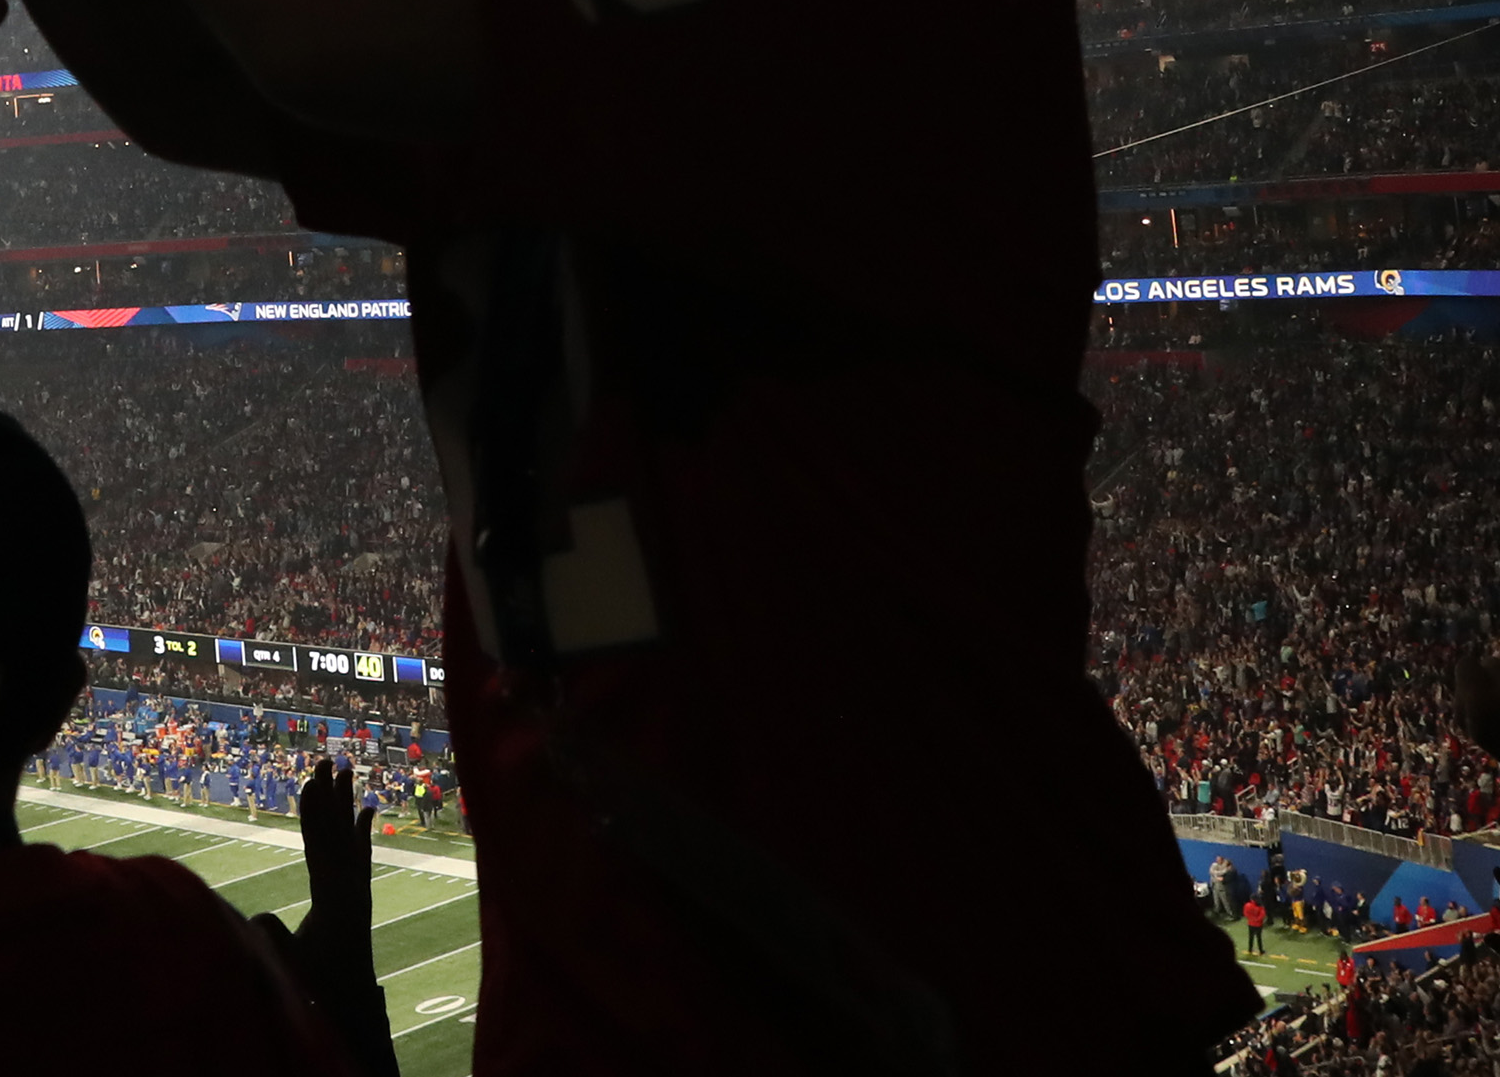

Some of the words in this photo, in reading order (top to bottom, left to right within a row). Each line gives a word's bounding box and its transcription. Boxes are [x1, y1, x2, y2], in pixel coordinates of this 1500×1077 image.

[1093, 280, 1141, 301] LOS
[1147, 276, 1268, 300] ANGELES
[1276, 274, 1356, 296] RAMS
[25, 314, 32, 329] 1
[255, 304, 287, 319] NEW
[289, 303, 359, 319] ENGLAND
[153, 635, 165, 655] 3
[166, 640, 185, 653] TOL
[186, 641, 198, 656] 2
[252, 649, 271, 662] QTR
[272, 651, 281, 663] 4
[309, 650, 349, 674] 7:00
[357, 654, 383, 678] 40
